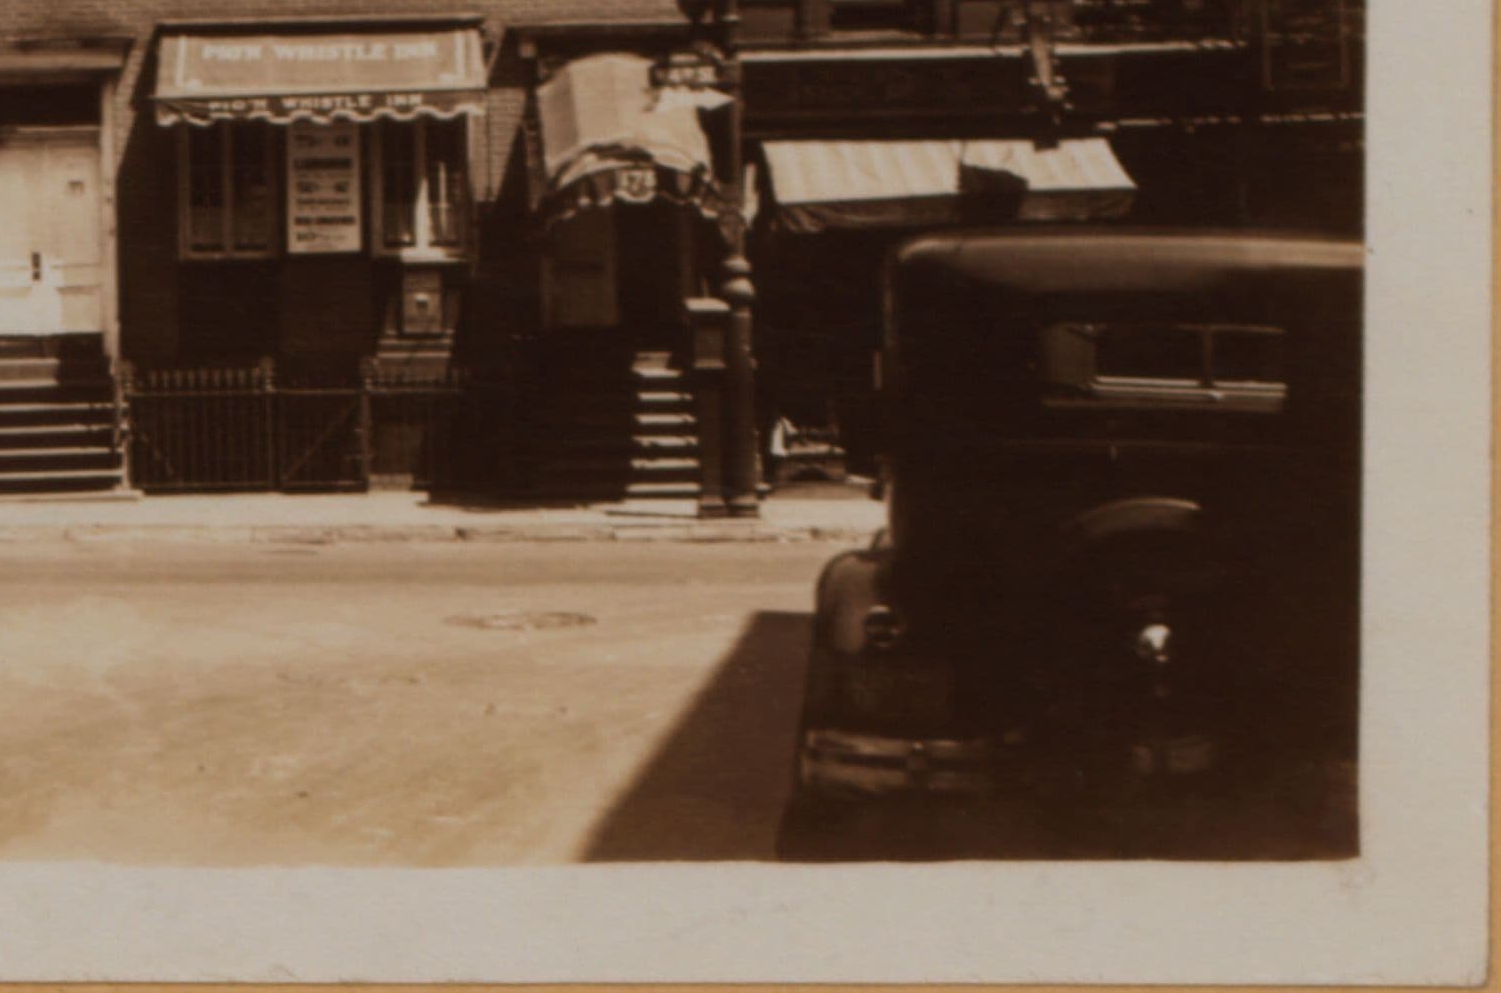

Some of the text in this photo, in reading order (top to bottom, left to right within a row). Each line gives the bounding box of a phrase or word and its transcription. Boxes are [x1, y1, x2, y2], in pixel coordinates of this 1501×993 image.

[272, 41, 387, 60] WHISTLE
[393, 41, 437, 58] INN
[282, 95, 372, 108] WHISTLE
[386, 93, 423, 106] INN
